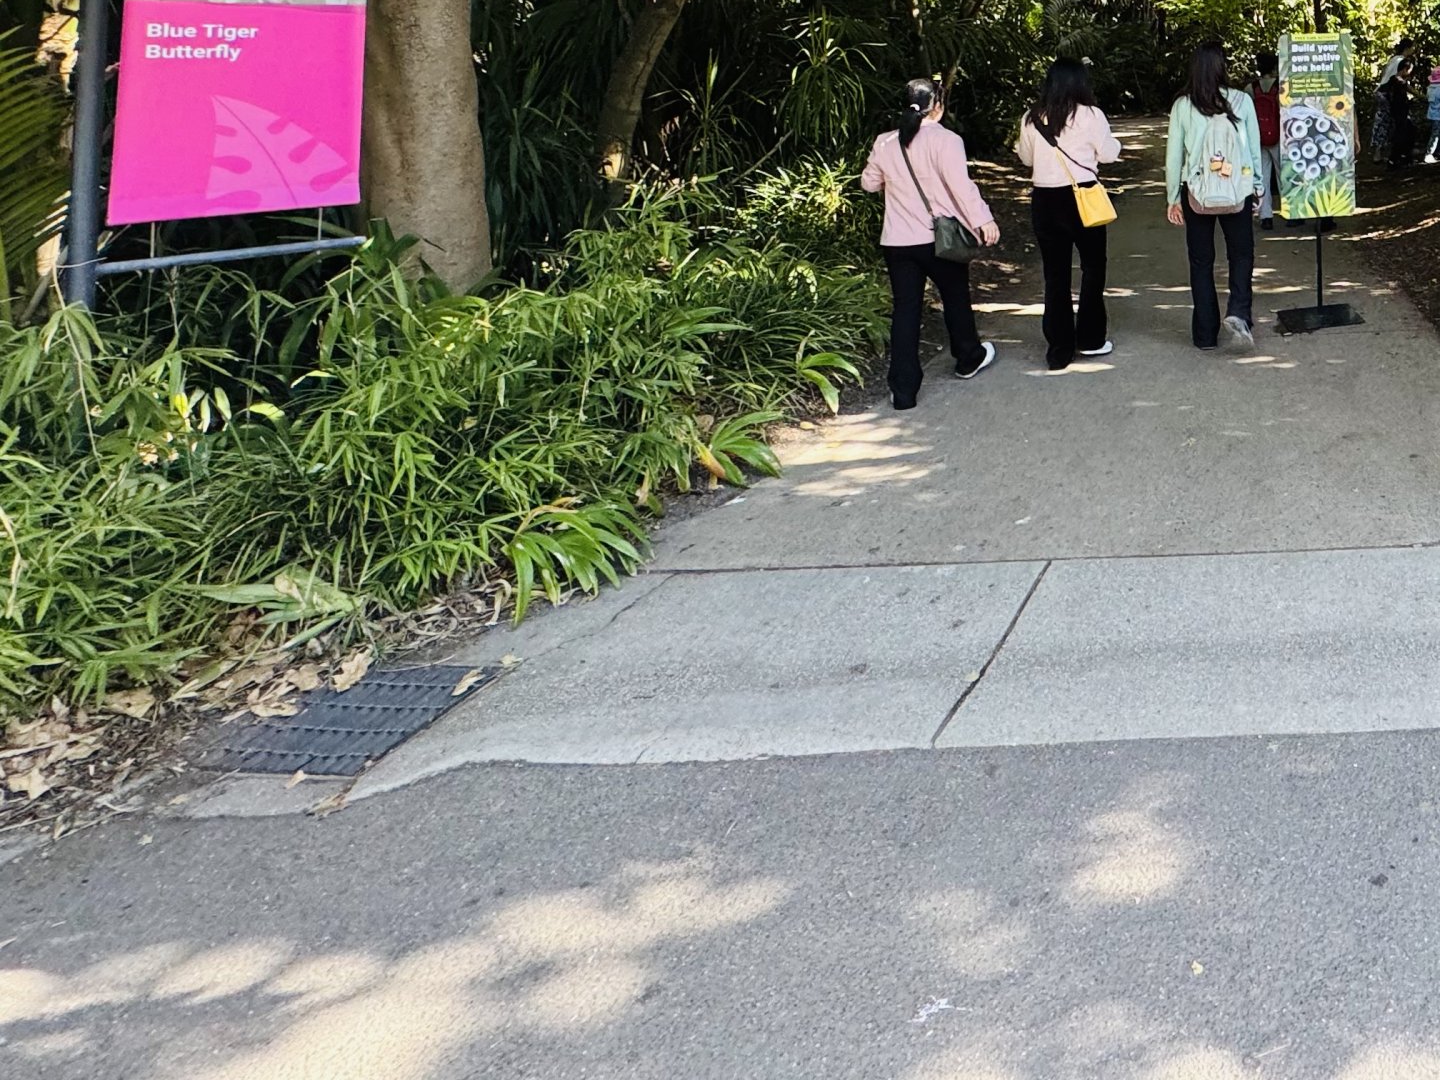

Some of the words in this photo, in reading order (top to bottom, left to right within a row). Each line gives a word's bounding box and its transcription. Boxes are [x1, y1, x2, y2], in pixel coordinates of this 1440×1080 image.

[146, 22, 198, 38] Blue
[202, 23, 259, 42] Tiger
[145, 43, 242, 62] Butterfly
[1291, 43, 1316, 53] Build
[1317, 44, 1339, 54] your
[1291, 55, 1310, 63] own
[1312, 52, 1341, 62] native
[1291, 64, 1309, 73] bee
[1310, 62, 1334, 72] hotel
